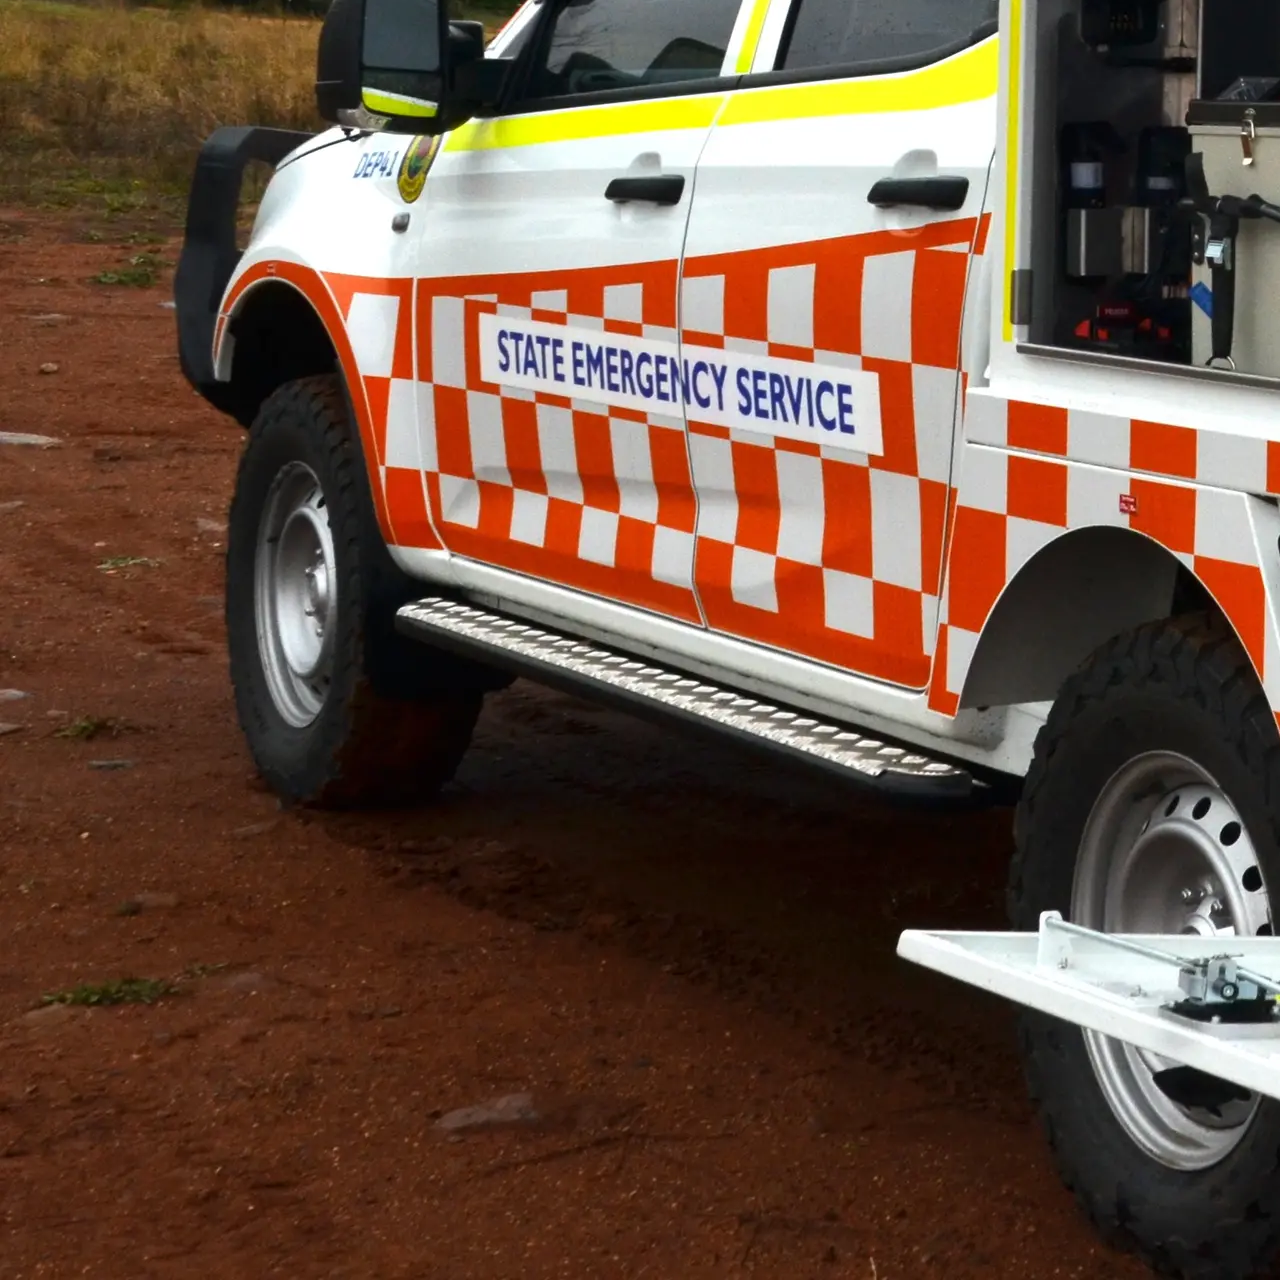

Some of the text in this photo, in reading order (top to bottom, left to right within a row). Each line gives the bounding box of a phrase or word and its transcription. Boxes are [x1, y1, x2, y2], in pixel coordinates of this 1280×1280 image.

[352, 150, 401, 179] DEP41
[497, 329, 856, 435] STATE EMERGENCY SERVICE
